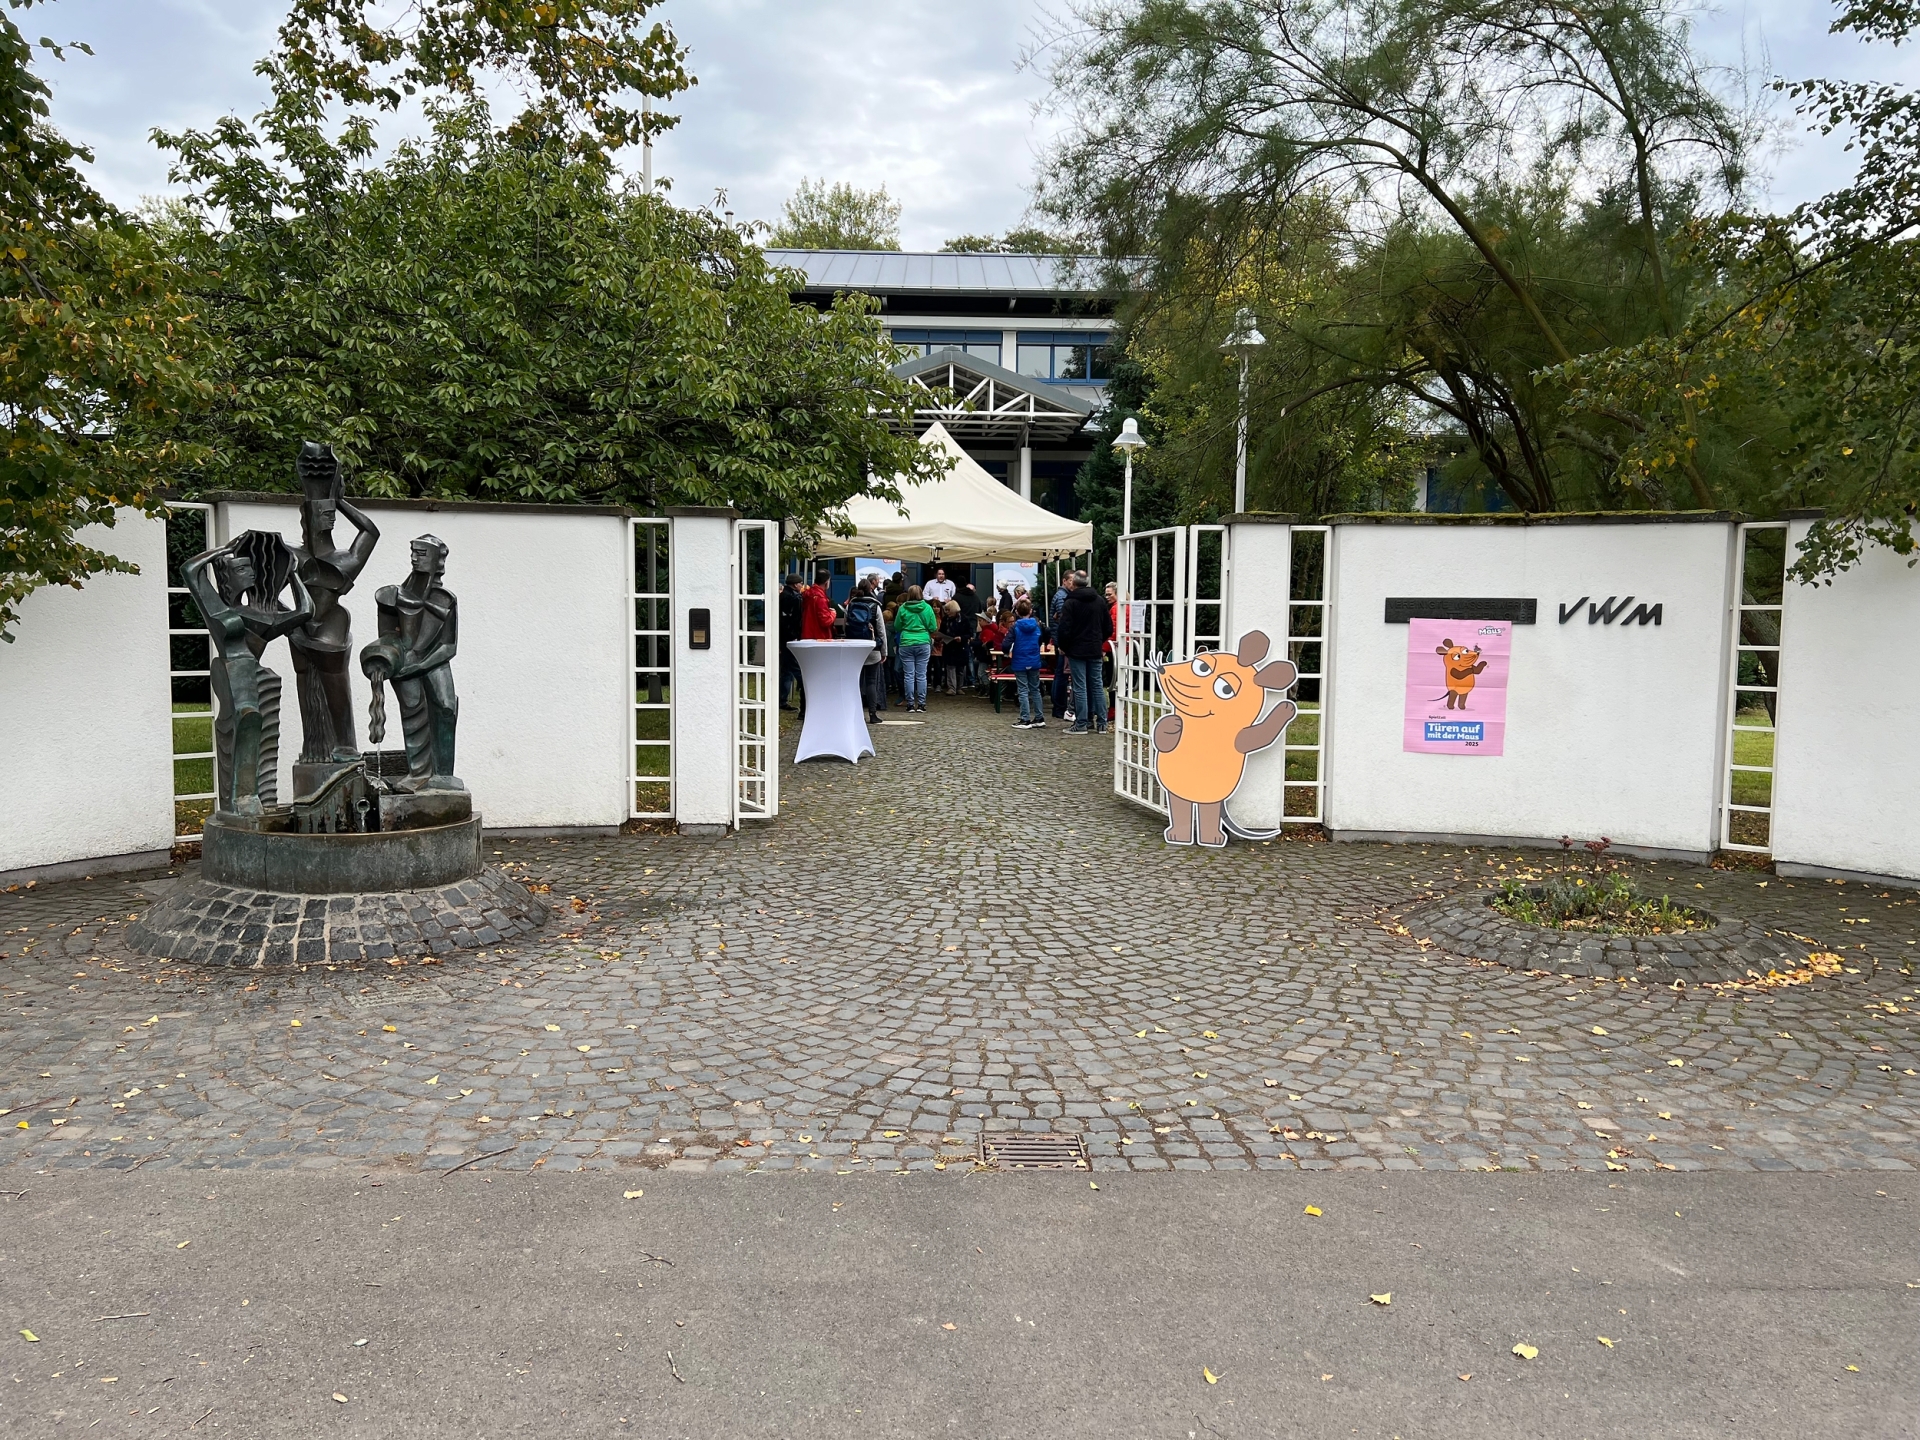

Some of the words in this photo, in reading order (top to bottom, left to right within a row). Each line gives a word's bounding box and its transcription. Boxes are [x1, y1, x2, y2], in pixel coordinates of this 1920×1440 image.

[1388, 600, 1449, 610] VEREINIGTE
[1454, 600, 1534, 611] WASSERWERKE
[1559, 597, 1662, 625] VWM
[1428, 723, 1459, 732] Türen
[1461, 725, 1480, 733] auf
[1442, 732, 1456, 740] der
